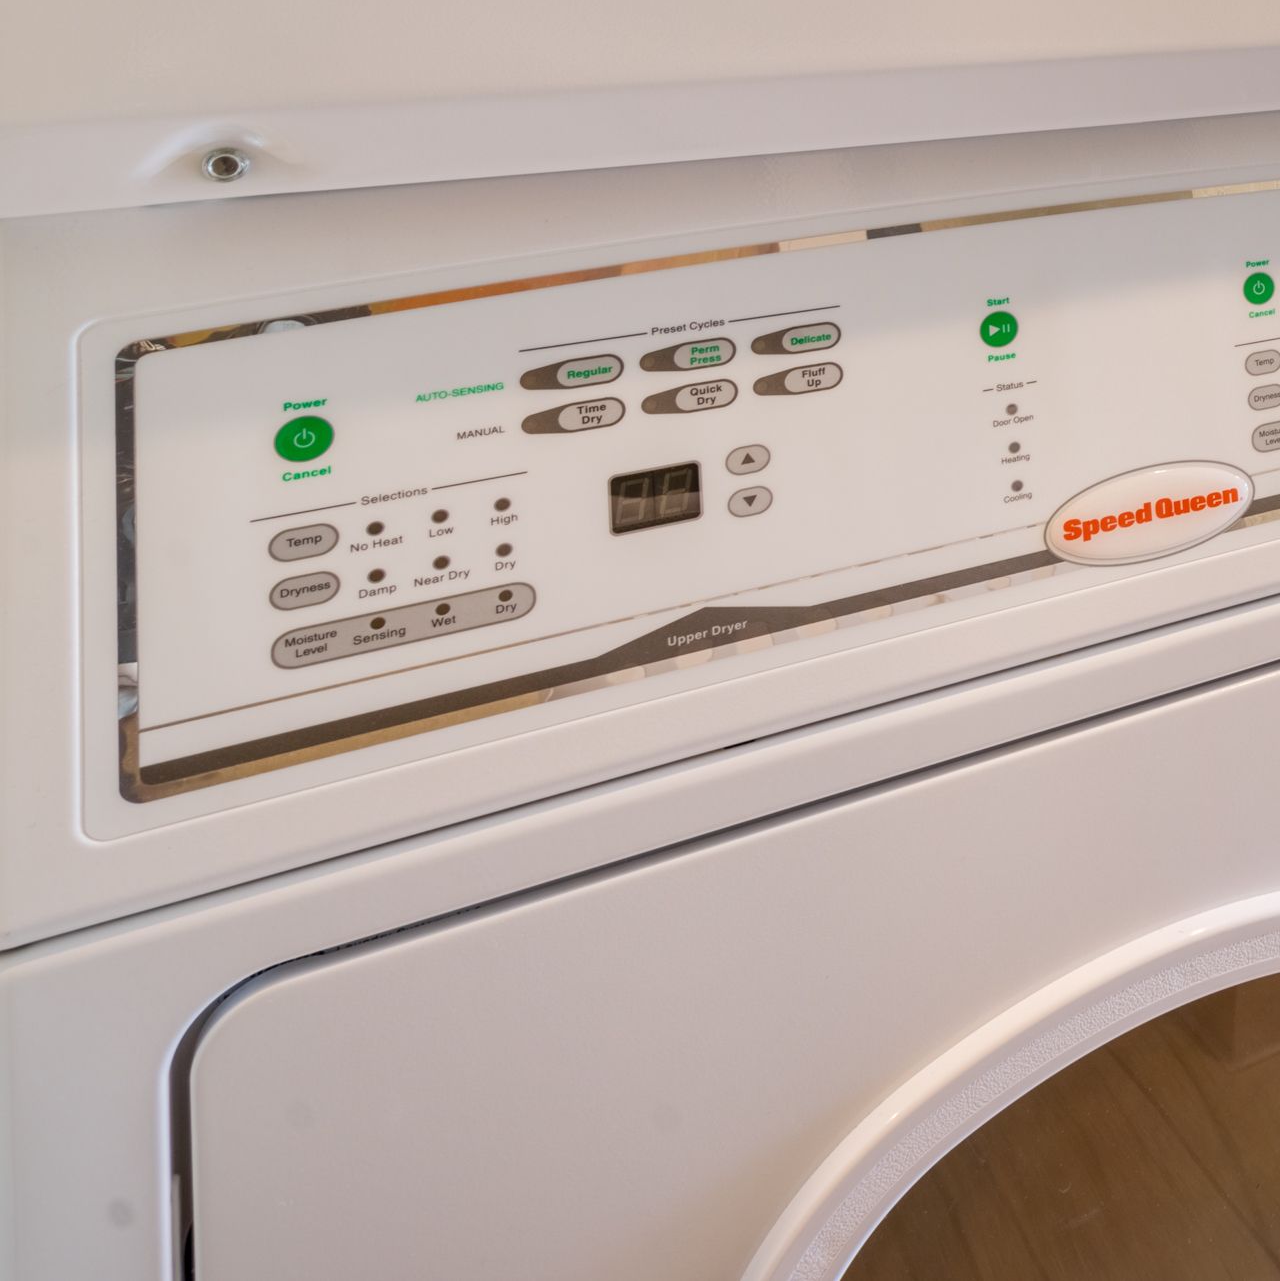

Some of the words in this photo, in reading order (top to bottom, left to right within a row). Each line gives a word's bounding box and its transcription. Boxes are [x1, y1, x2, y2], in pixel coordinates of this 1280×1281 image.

[1246, 259, 1270, 268] Power
[987, 297, 1010, 307] Start
[1249, 308, 1276, 319] Cancel
[651, 324, 687, 336] Preset
[689, 318, 725, 332] Cycles
[790, 332, 832, 346] Delicate
[691, 344, 720, 355] Perm
[690, 353, 722, 365] Press
[987, 352, 1016, 363] Pause
[1255, 358, 1275, 367] Temp
[567, 365, 613, 380] Regular
[801, 367, 826, 379] Fluff
[806, 378, 822, 388] Up
[996, 380, 1024, 392] Status
[415, 381, 505, 403] AUTO-SENSING
[690, 384, 722, 397] Quick
[283, 397, 328, 412] Power
[697, 395, 717, 406] Dry
[577, 403, 607, 415] Time
[581, 413, 603, 426] Dry
[993, 418, 1012, 428] Door
[1014, 414, 1034, 425] Open
[456, 425, 505, 440] MANUAL
[1001, 453, 1031, 465] Heating
[282, 465, 332, 482] Cancel
[361, 487, 428, 506] Selections
[1004, 491, 1033, 504] Cooling
[490, 513, 518, 526] High
[1063, 502, 1152, 542] Speed
[1155, 488, 1239, 519] Queen
[429, 526, 454, 538] Low
[286, 533, 323, 548] Temp
[350, 541, 368, 553] No
[373, 536, 403, 549] Heat
[495, 559, 516, 572] Dry
[414, 574, 444, 587] Near
[448, 568, 471, 582] Dry
[280, 581, 331, 599] Dryness
[358, 583, 397, 599] Damp
[495, 602, 518, 615] Dry
[431, 615, 457, 628] Wet
[284, 629, 338, 648] Moisture
[353, 626, 407, 646] Sensing
[667, 630, 708, 646] Upper
[712, 620, 748, 636] Dryer
[295, 643, 328, 659] Level
